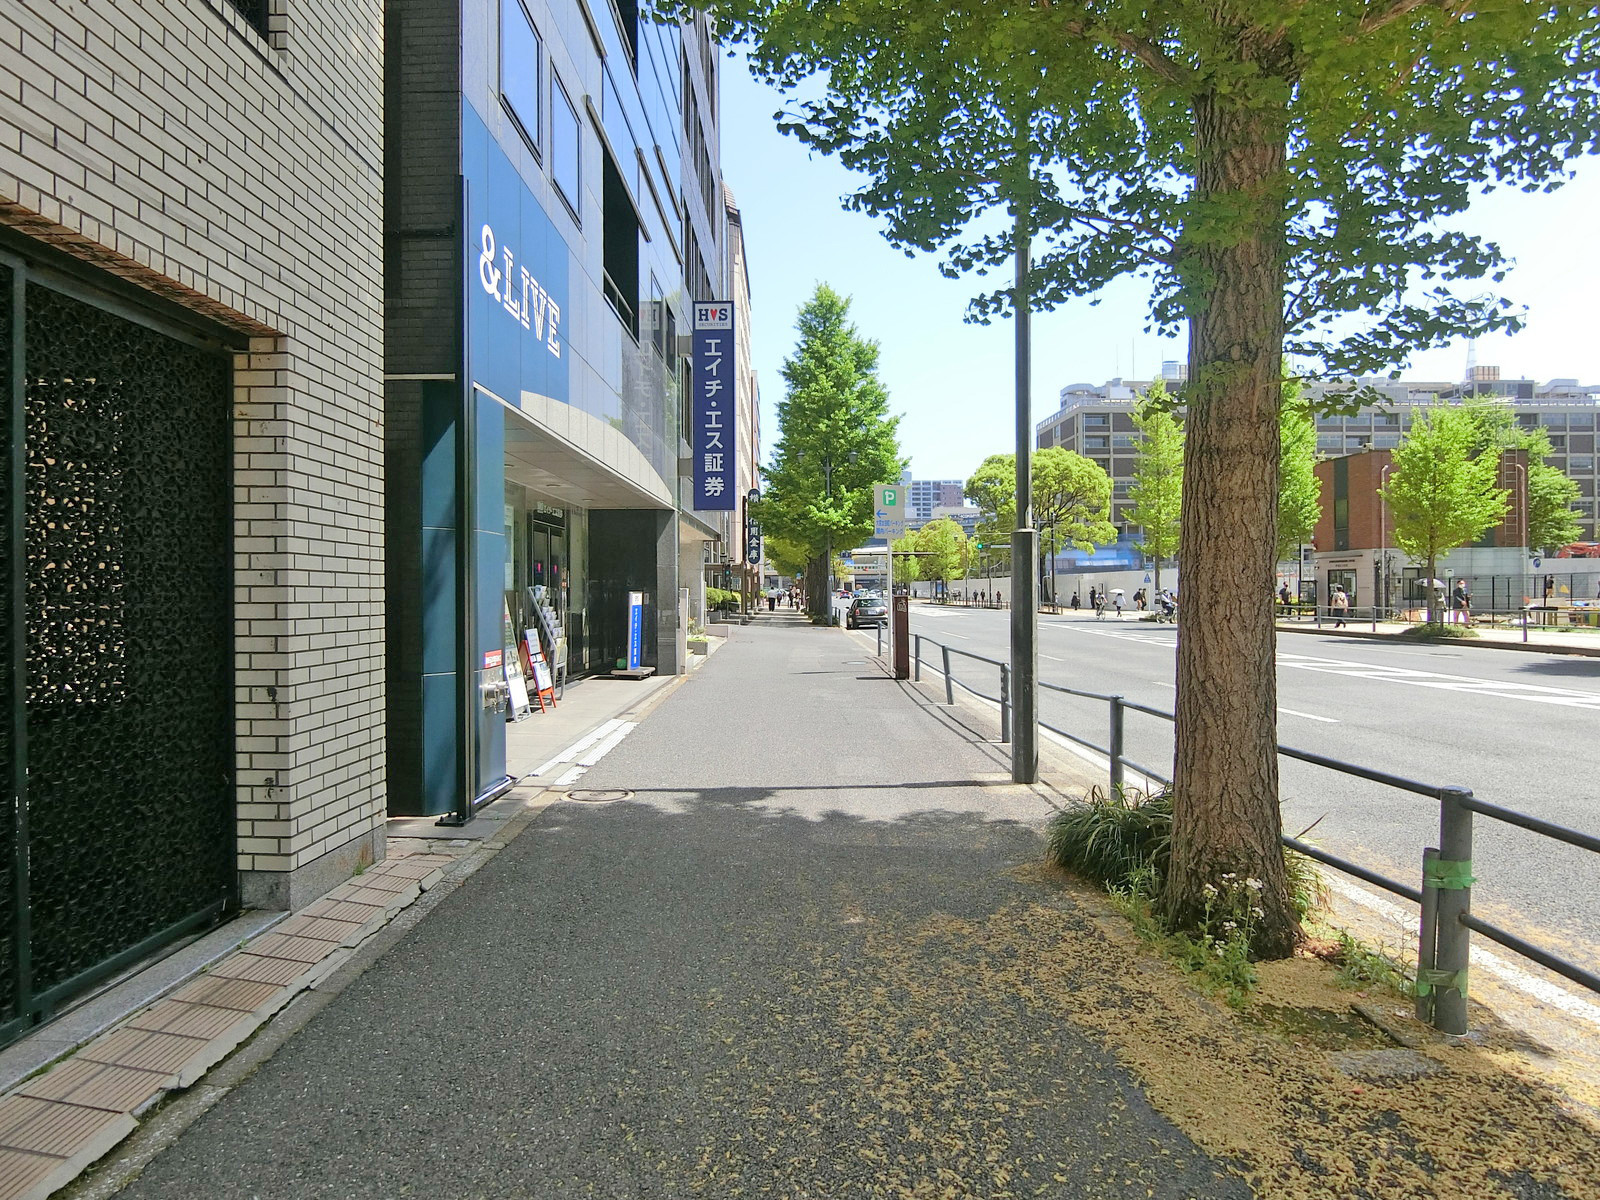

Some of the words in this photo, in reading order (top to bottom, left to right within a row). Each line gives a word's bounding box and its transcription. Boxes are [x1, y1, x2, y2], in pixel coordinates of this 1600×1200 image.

[479, 224, 561, 359] &LIVE
[703, 339, 725, 497] エイチ・エス証券
[749, 493, 760, 560] 横信用金庫
[886, 490, 895, 505] P
